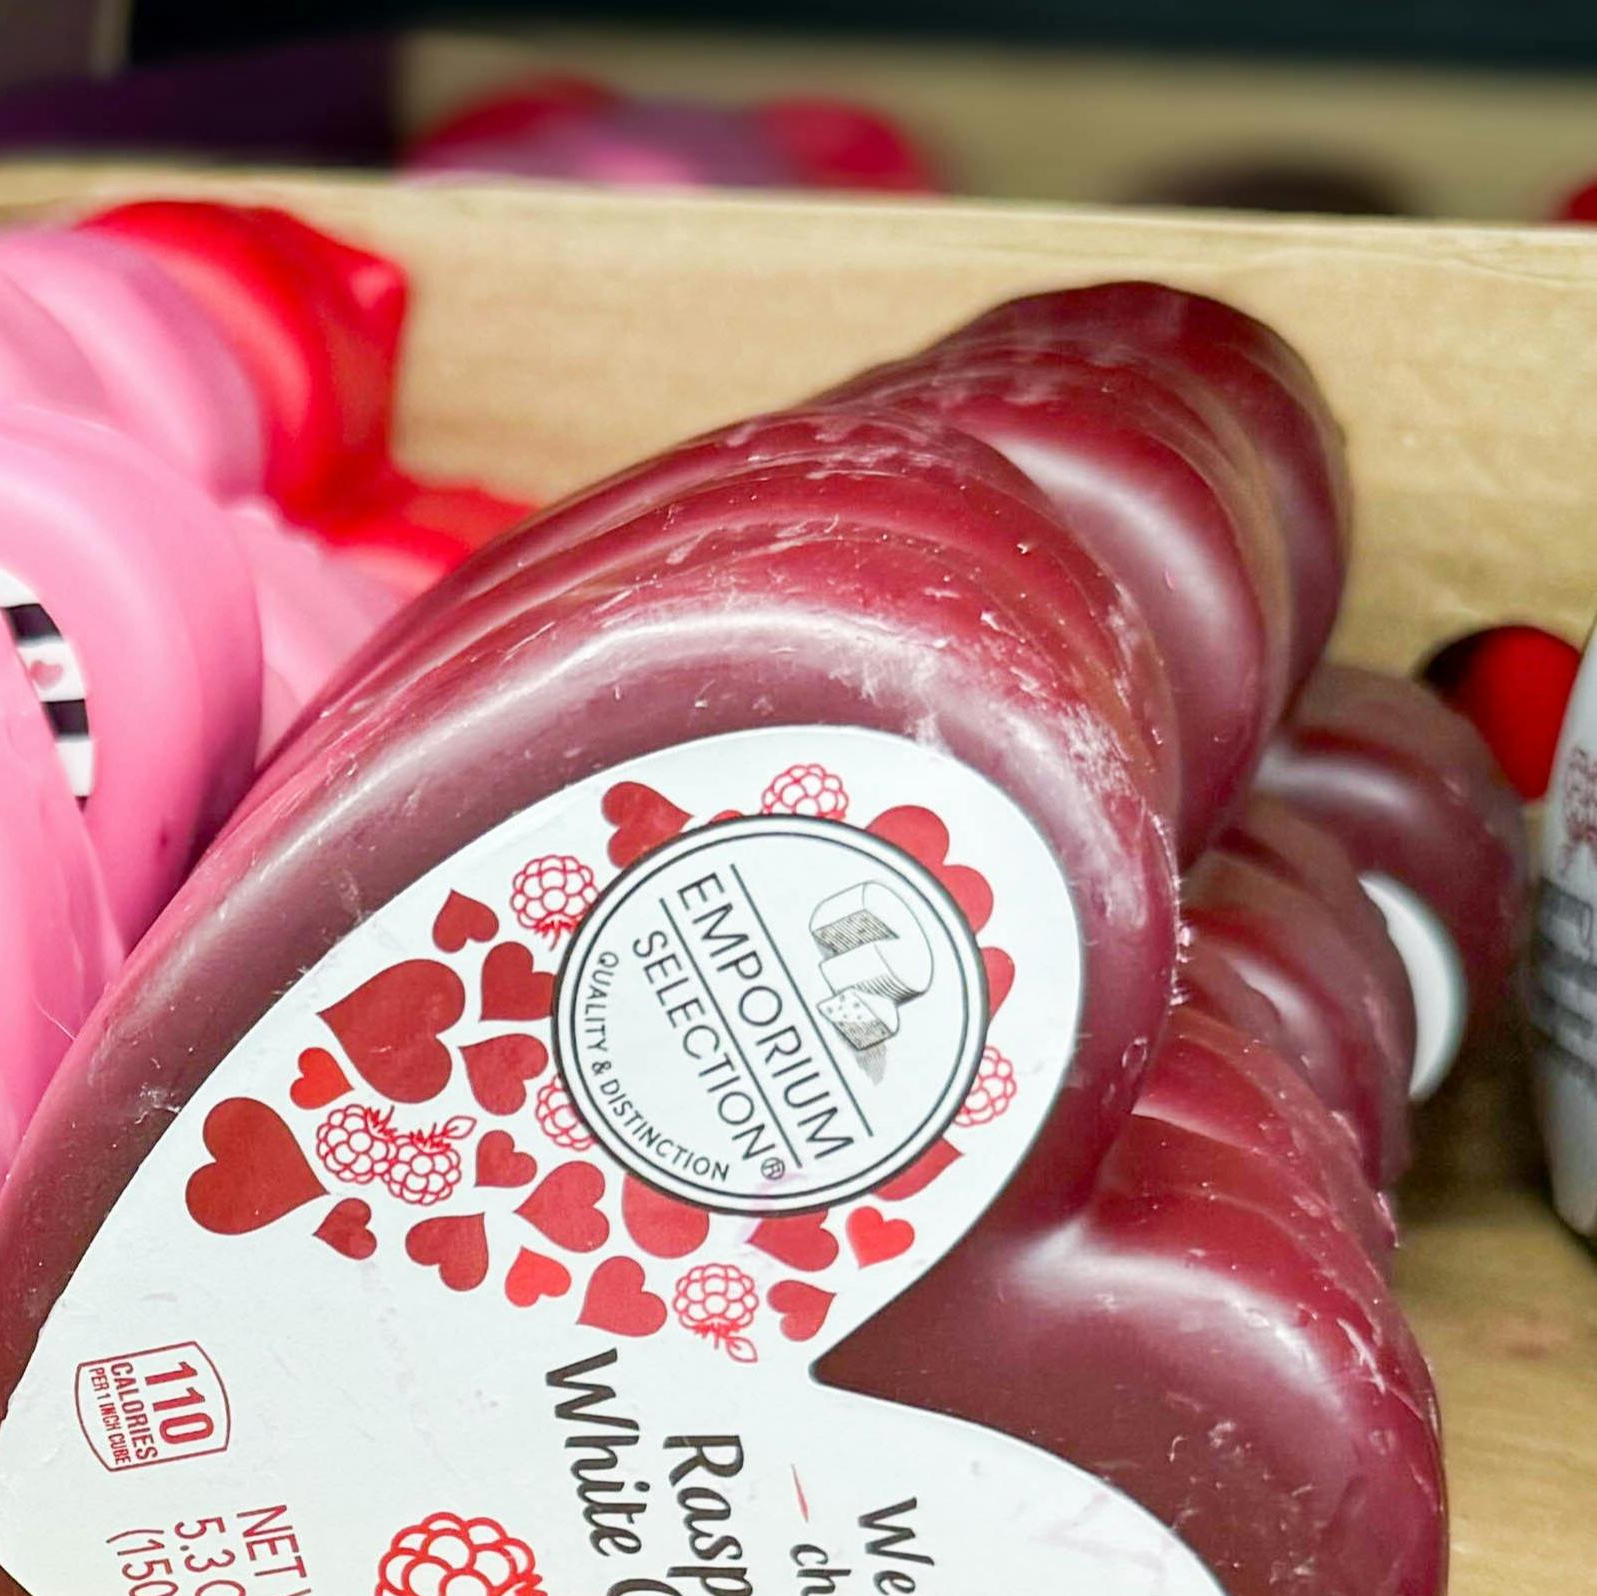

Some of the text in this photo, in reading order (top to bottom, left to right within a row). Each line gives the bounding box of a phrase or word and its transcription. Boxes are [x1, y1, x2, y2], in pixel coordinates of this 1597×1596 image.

[677, 872, 855, 1160] EMPORIUM
[585, 950, 730, 1183] QUALITY & DISTINCTION
[89, 1366, 110, 1393] PER
[98, 1401, 121, 1433] INCH
[110, 1361, 160, 1461] CALORIES
[143, 1360, 216, 1445] 110
[109, 1432, 133, 1466] CUBE
[545, 1346, 652, 1558] White
[174, 1516, 237, 1575] 5.3
[236, 1504, 308, 1578] NET
